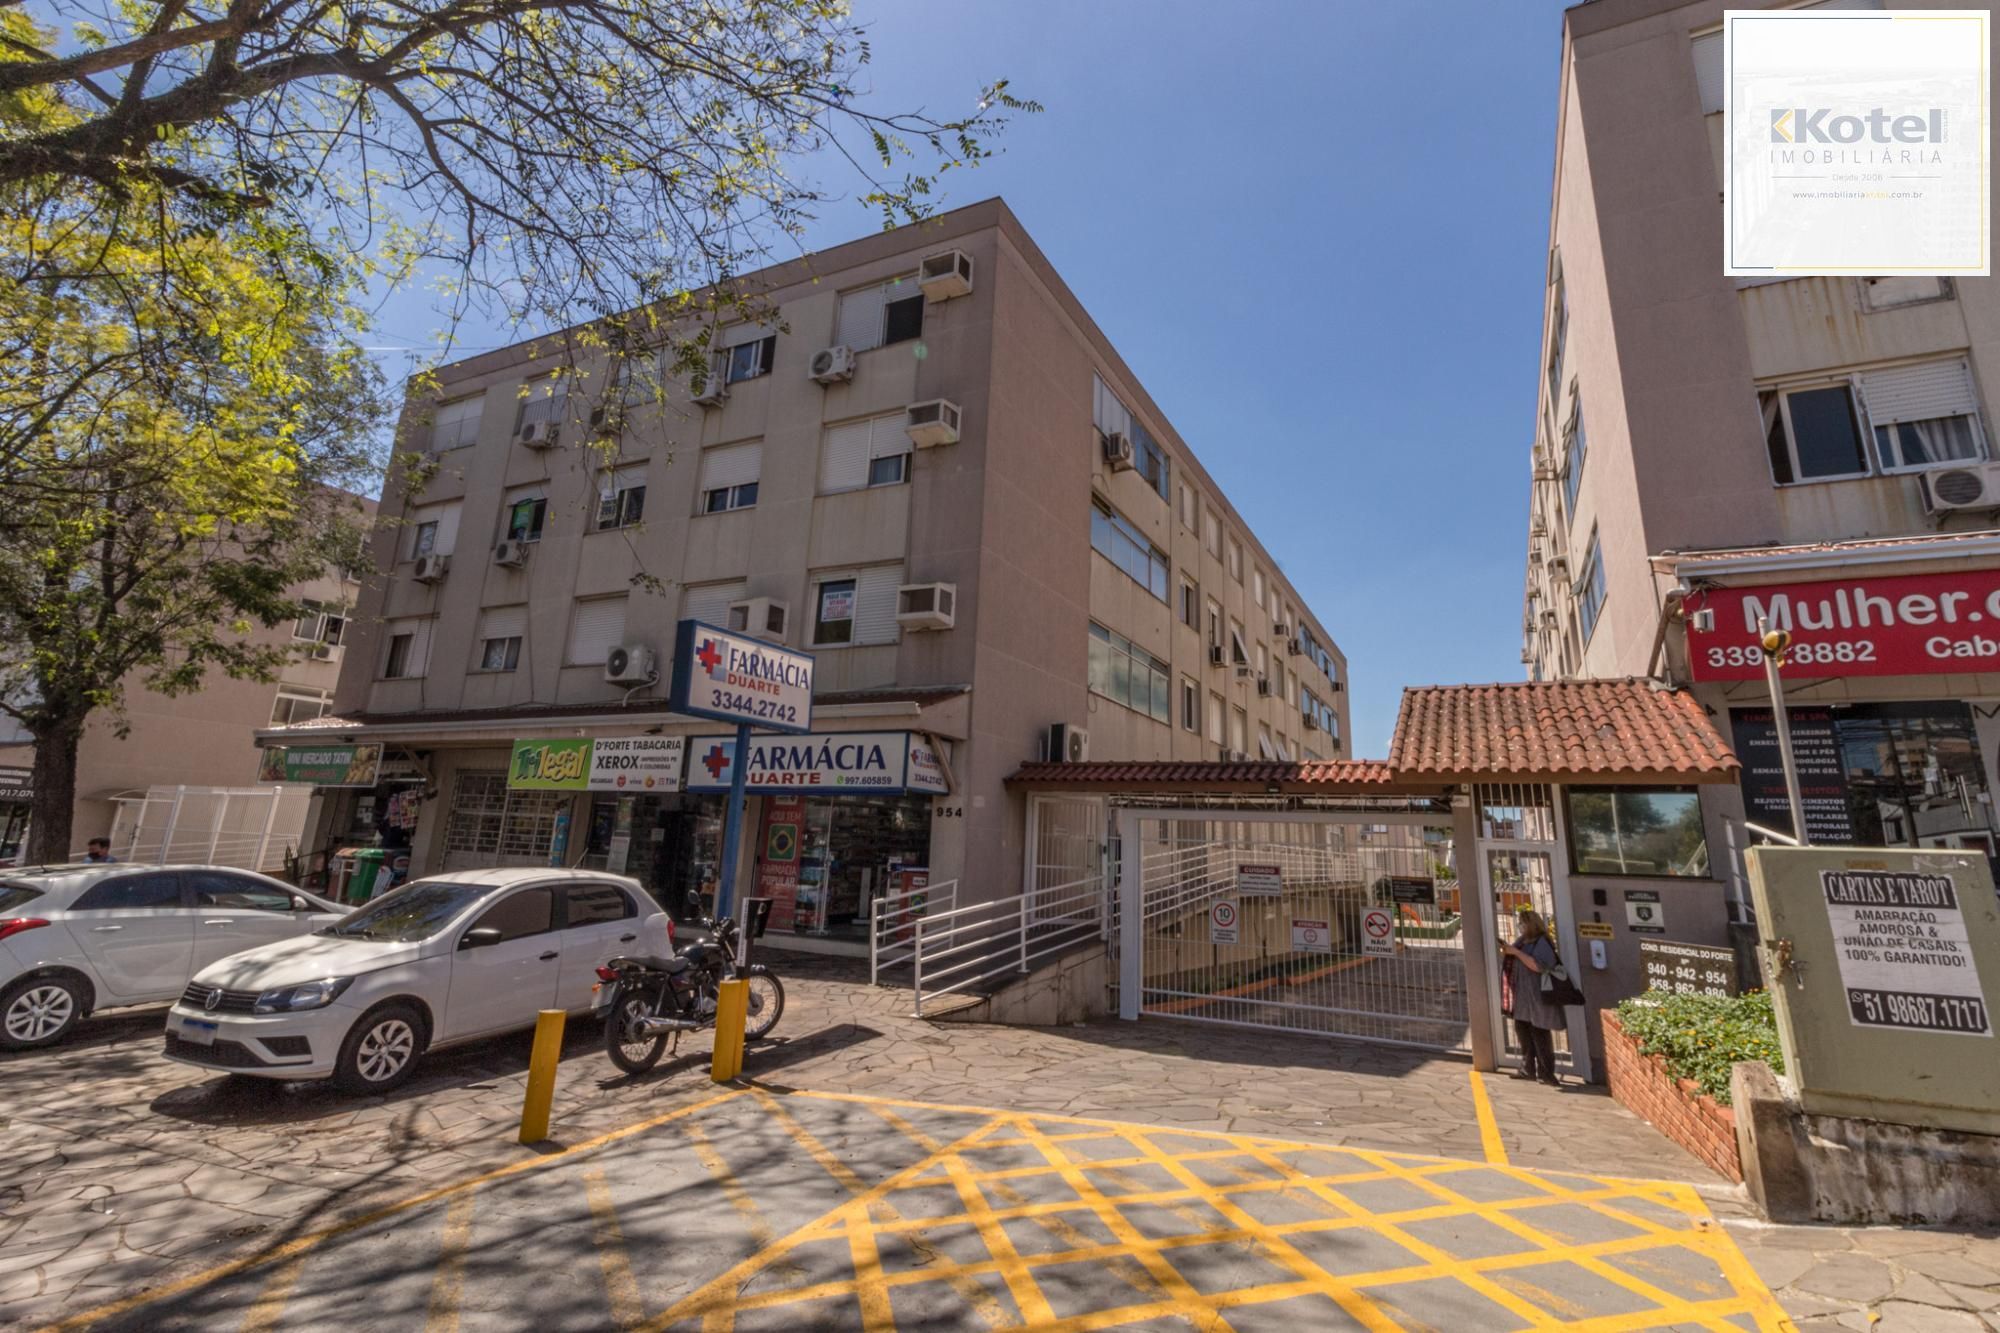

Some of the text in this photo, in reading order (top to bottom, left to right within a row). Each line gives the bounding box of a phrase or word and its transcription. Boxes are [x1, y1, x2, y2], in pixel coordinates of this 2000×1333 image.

[1708, 640, 1877, 667] 339.8882
[1925, 635, 2000, 658] Cab
[729, 648, 809, 690] FARMÁCIA
[728, 674, 781, 696] DUARTE
[712, 689, 796, 722] 3344.2742
[633, 740, 681, 750] TABACARIA
[596, 755, 640, 770] XEROX
[936, 807, 962, 817] 954
[1828, 875, 1949, 906] CARTAS E TAROT
[1218, 908, 1231, 918] 10
[1854, 909, 1937, 926] AMARRAÇÃO
[1859, 924, 1939, 937] AMOROSA &
[1370, 938, 1387, 946] NÃO
[1843, 936, 1883, 948] UNIÃO
[1659, 946, 1699, 958] RESIDENCIAL
[1700, 950, 1710, 959] DO
[1710, 952, 1734, 962] FORTE
[1845, 950, 1966, 967] 100% GARANTIDO!
[1647, 962, 1667, 975] 940
[1675, 966, 1696, 980] 942
[1705, 971, 1727, 985] 954
[1675, 982, 1695, 994] 962
[1862, 993, 1983, 1030] 51 98687.1717
